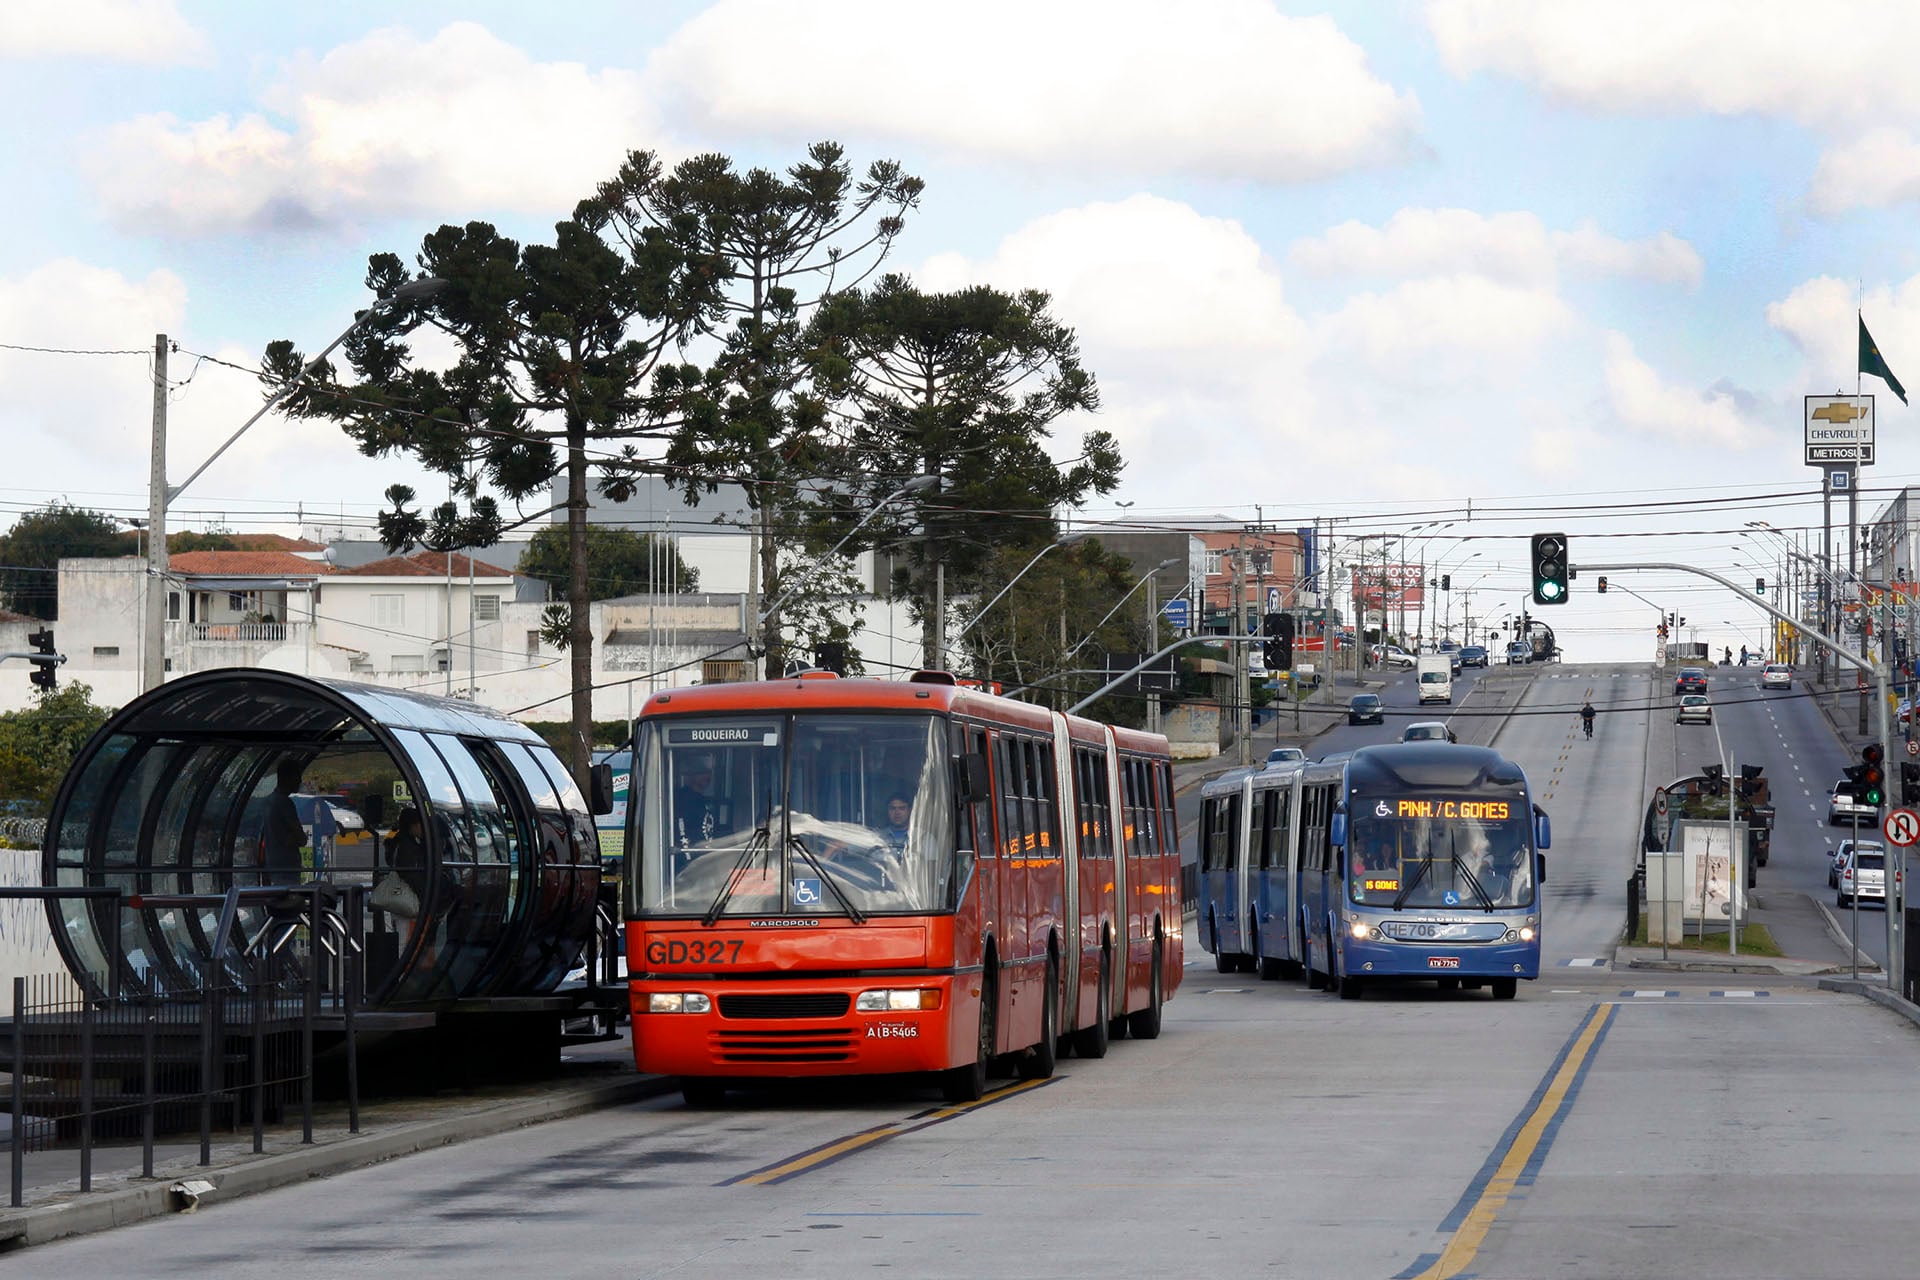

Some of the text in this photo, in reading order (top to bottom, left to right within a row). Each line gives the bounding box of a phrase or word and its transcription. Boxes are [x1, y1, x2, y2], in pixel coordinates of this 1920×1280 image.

[691, 729, 749, 741] BOQUEIRAO
[1460, 802, 1509, 819] GOMES
[750, 919, 820, 927] MARCOPOLO
[1387, 924, 1436, 937] HE706
[646, 940, 744, 965] GD327
